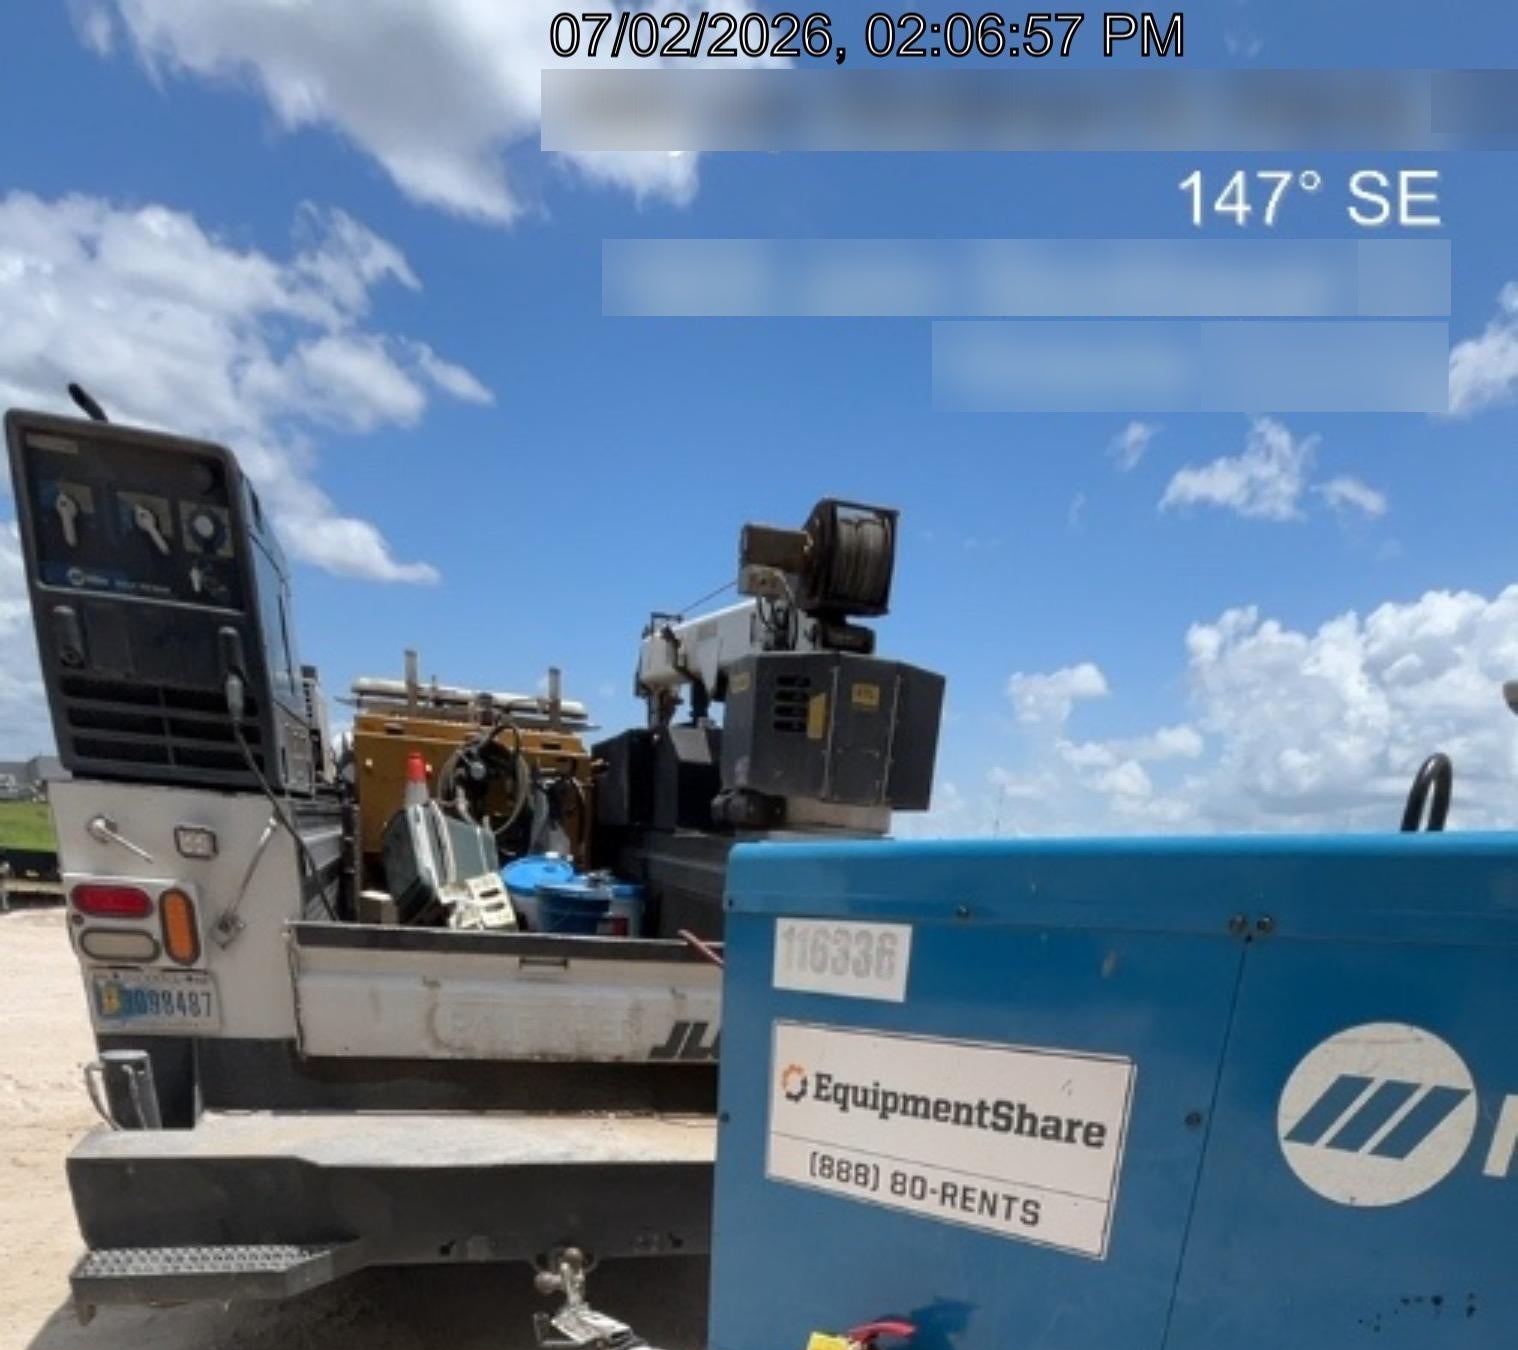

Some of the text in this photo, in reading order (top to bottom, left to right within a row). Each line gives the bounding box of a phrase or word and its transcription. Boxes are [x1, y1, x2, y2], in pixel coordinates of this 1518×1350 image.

[813, 1072, 1106, 1150] EquipmentShare
[809, 1151, 1042, 1228] (888) 80-RENTS
